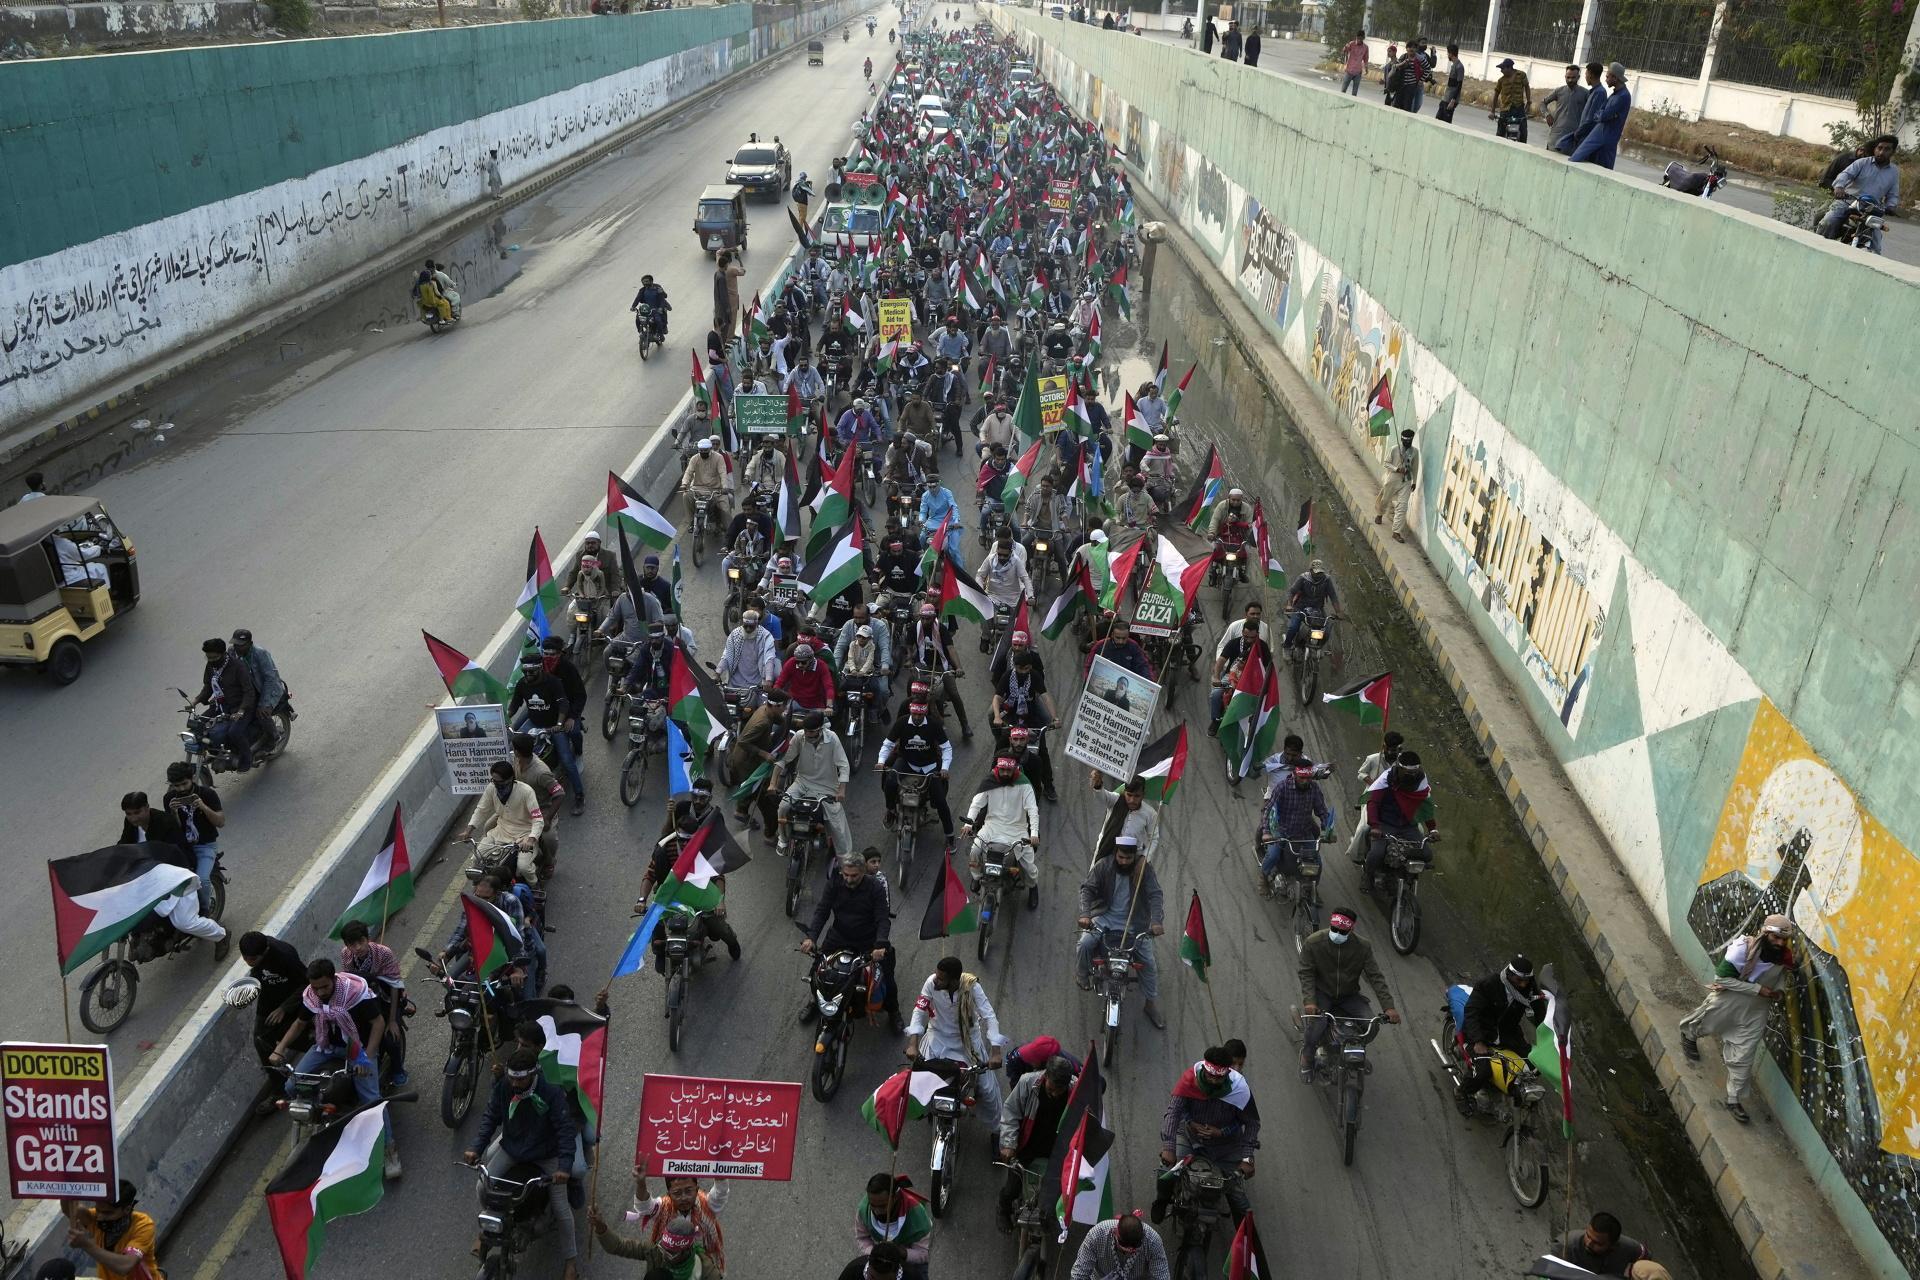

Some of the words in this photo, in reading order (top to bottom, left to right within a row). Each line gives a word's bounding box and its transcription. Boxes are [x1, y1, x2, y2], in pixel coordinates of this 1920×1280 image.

[1051, 199, 1070, 209] GAZA
[1040, 391, 1065, 403] OCTORS
[774, 588, 798, 598] FREE
[1136, 603, 1173, 624] GAZA
[1079, 702, 1101, 719] Hana
[1103, 714, 1142, 740] Hammad
[1083, 694, 1115, 716] Palestinian
[1114, 710, 1144, 730] Journalist
[445, 748, 467, 757] Hana
[469, 747, 507, 756] Hammad
[1075, 738, 1086, 749] be
[1088, 746, 1125, 767] silenced
[1076, 728, 1090, 741] We
[1091, 736, 1112, 752] shall
[1113, 747, 1130, 761] not
[7, 1055, 100, 1077] DOCTORS
[5, 1085, 108, 1121] Stands
[648, 1103, 698, 1129] الجانب
[699, 1108, 724, 1129] على
[725, 1109, 789, 1131] العنصرية
[39, 1124, 78, 1142] with
[655, 1129, 707, 1154] التاريخ
[15, 1135, 105, 1173] Gaza
[708, 1140, 732, 1155] من
[668, 1161, 710, 1173] Pakistani
[27, 1182, 68, 1191] KARACHI
[68, 1183, 100, 1192] YOUTH
